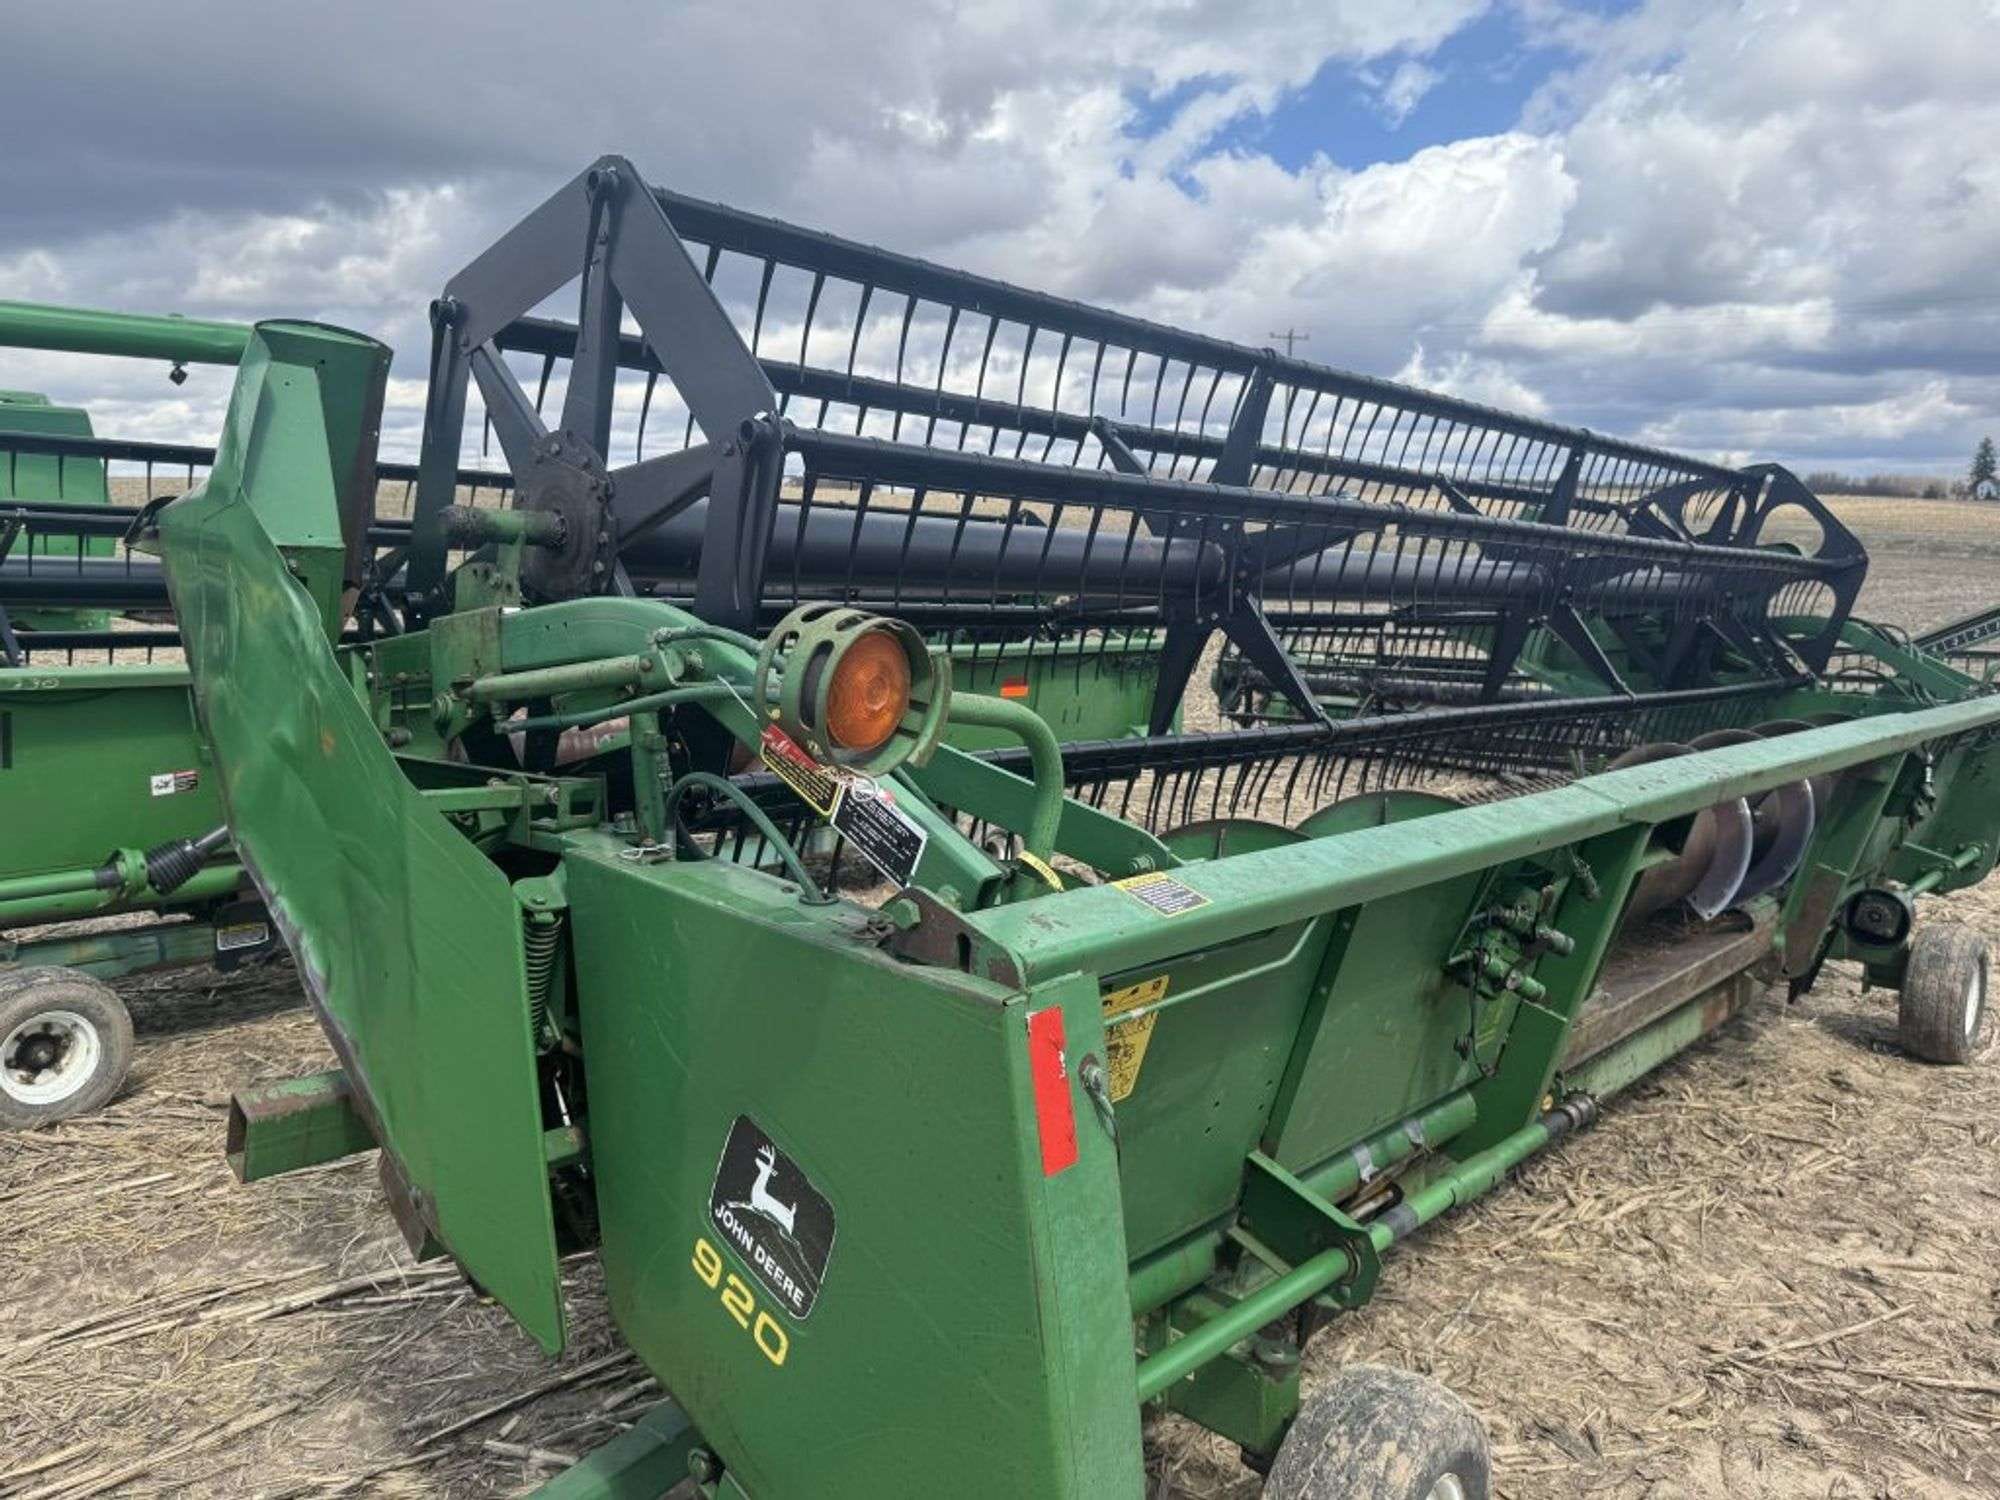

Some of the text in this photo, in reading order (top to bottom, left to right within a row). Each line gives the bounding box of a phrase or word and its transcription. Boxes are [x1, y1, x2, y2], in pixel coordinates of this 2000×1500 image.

[691, 1238, 789, 1366] 920
[714, 1207, 805, 1308] JOHN DEERE
